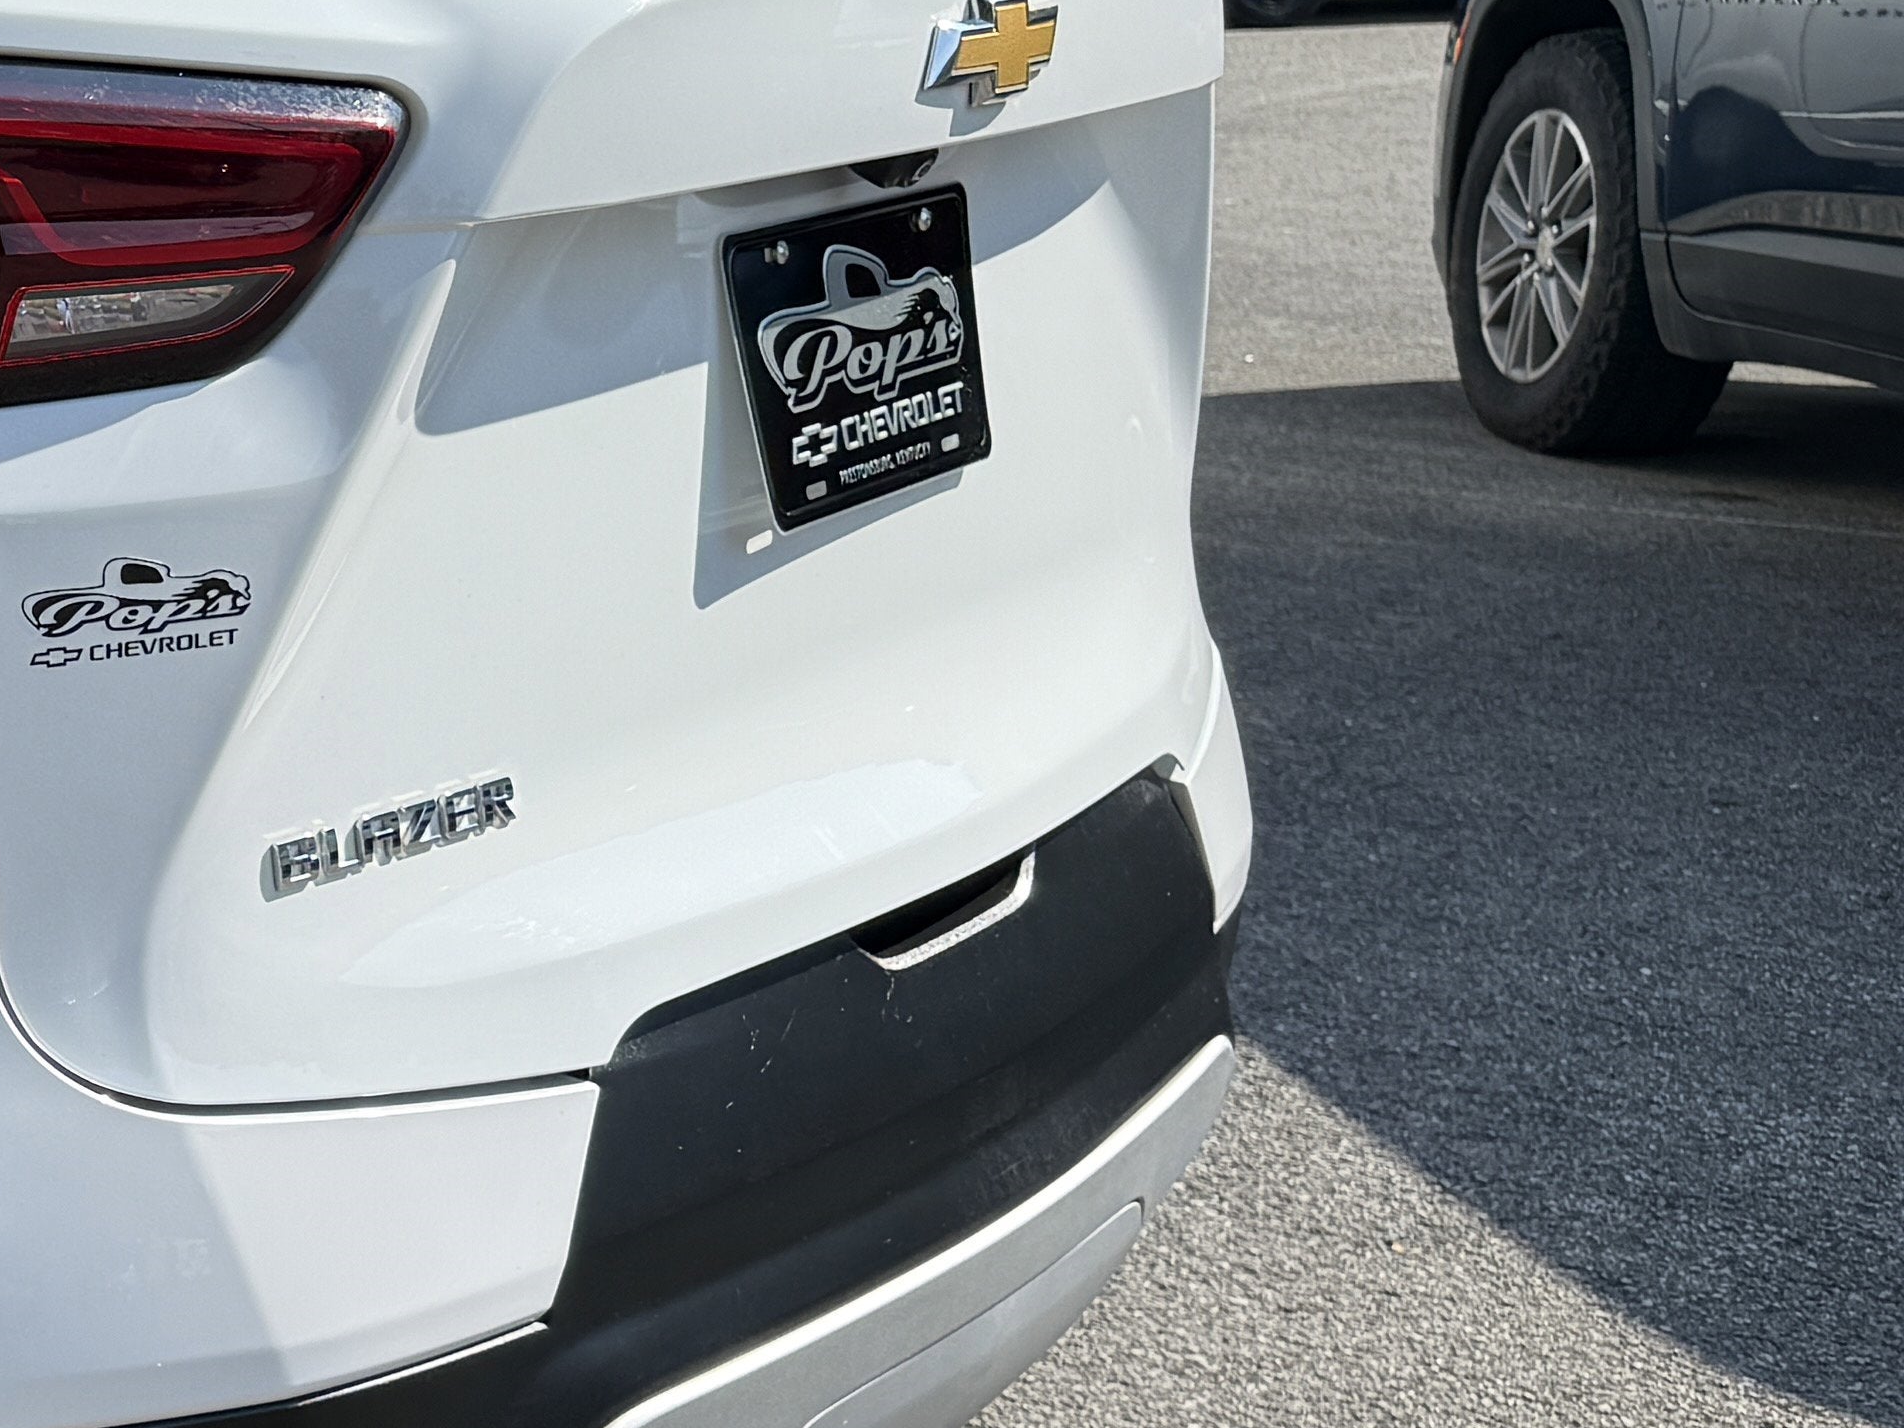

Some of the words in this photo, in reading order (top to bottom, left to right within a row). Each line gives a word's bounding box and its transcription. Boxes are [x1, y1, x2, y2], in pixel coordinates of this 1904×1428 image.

[840, 381, 963, 451] CHEVROLET
[89, 628, 239, 661] CHEVROLET
[262, 775, 516, 894] BLAZER
